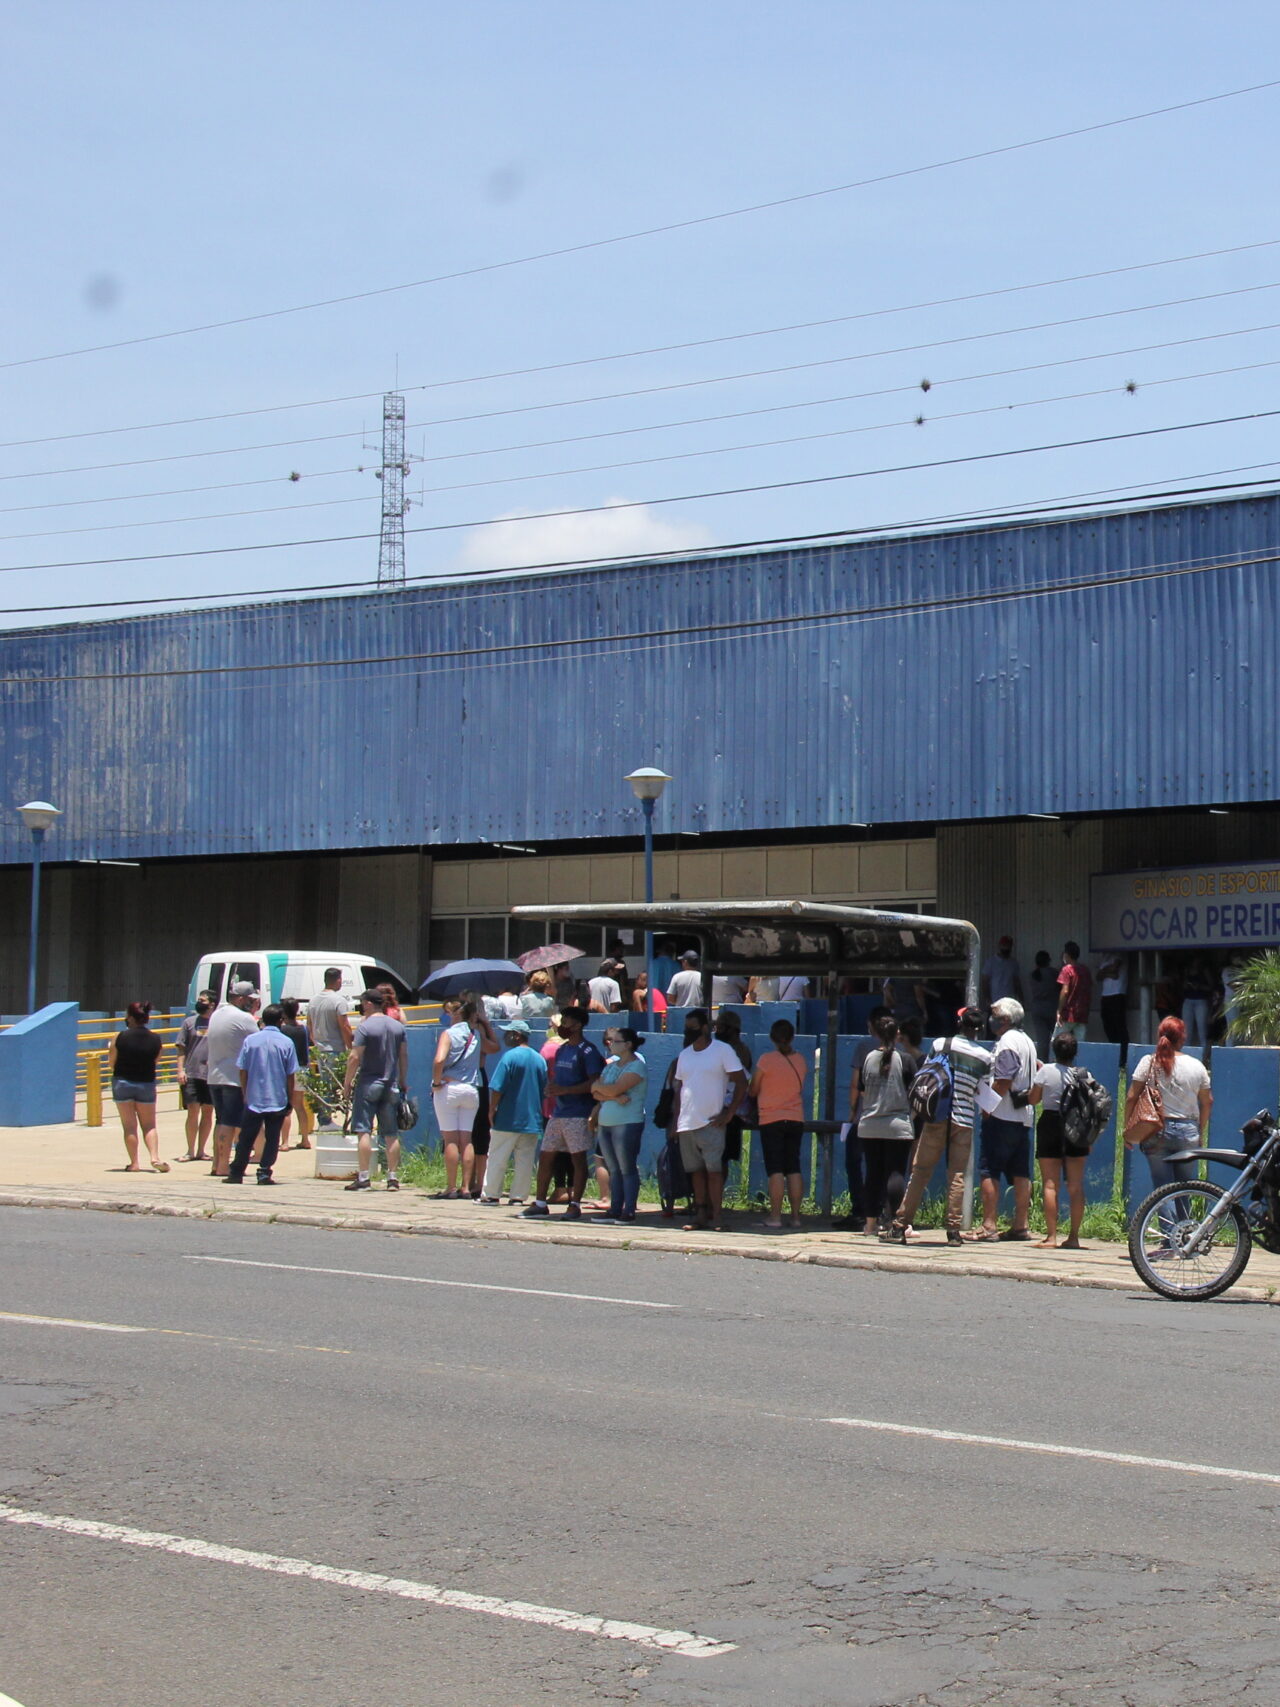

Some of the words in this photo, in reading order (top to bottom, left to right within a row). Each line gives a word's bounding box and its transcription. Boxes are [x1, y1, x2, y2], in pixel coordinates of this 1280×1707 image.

[1131, 871, 1193, 899] GINÁSIO
[1196, 873, 1216, 897] DE
[1119, 906, 1198, 941] OSCAR
